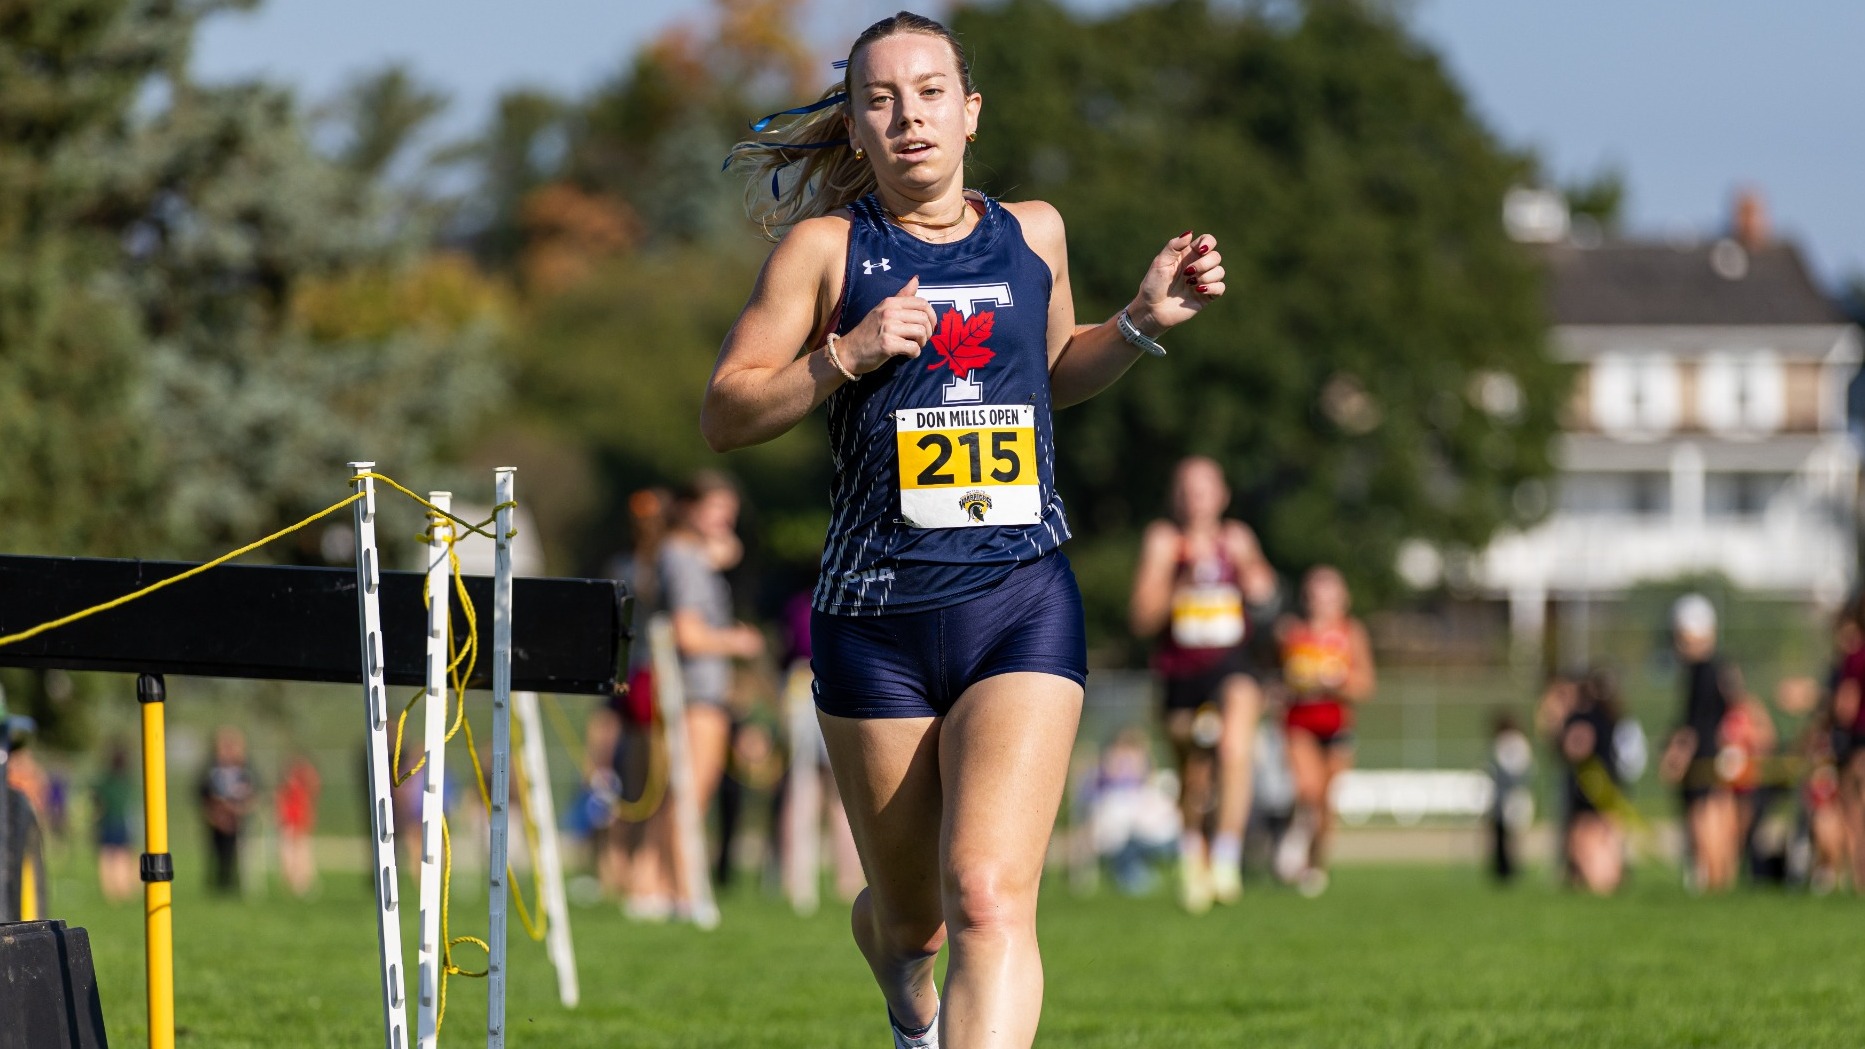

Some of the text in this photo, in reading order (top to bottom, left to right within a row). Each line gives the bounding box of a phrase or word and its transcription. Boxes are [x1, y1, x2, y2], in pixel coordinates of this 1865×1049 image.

[916, 408, 1020, 429] DON MILLS OPEN
[916, 431, 1021, 486] 215
